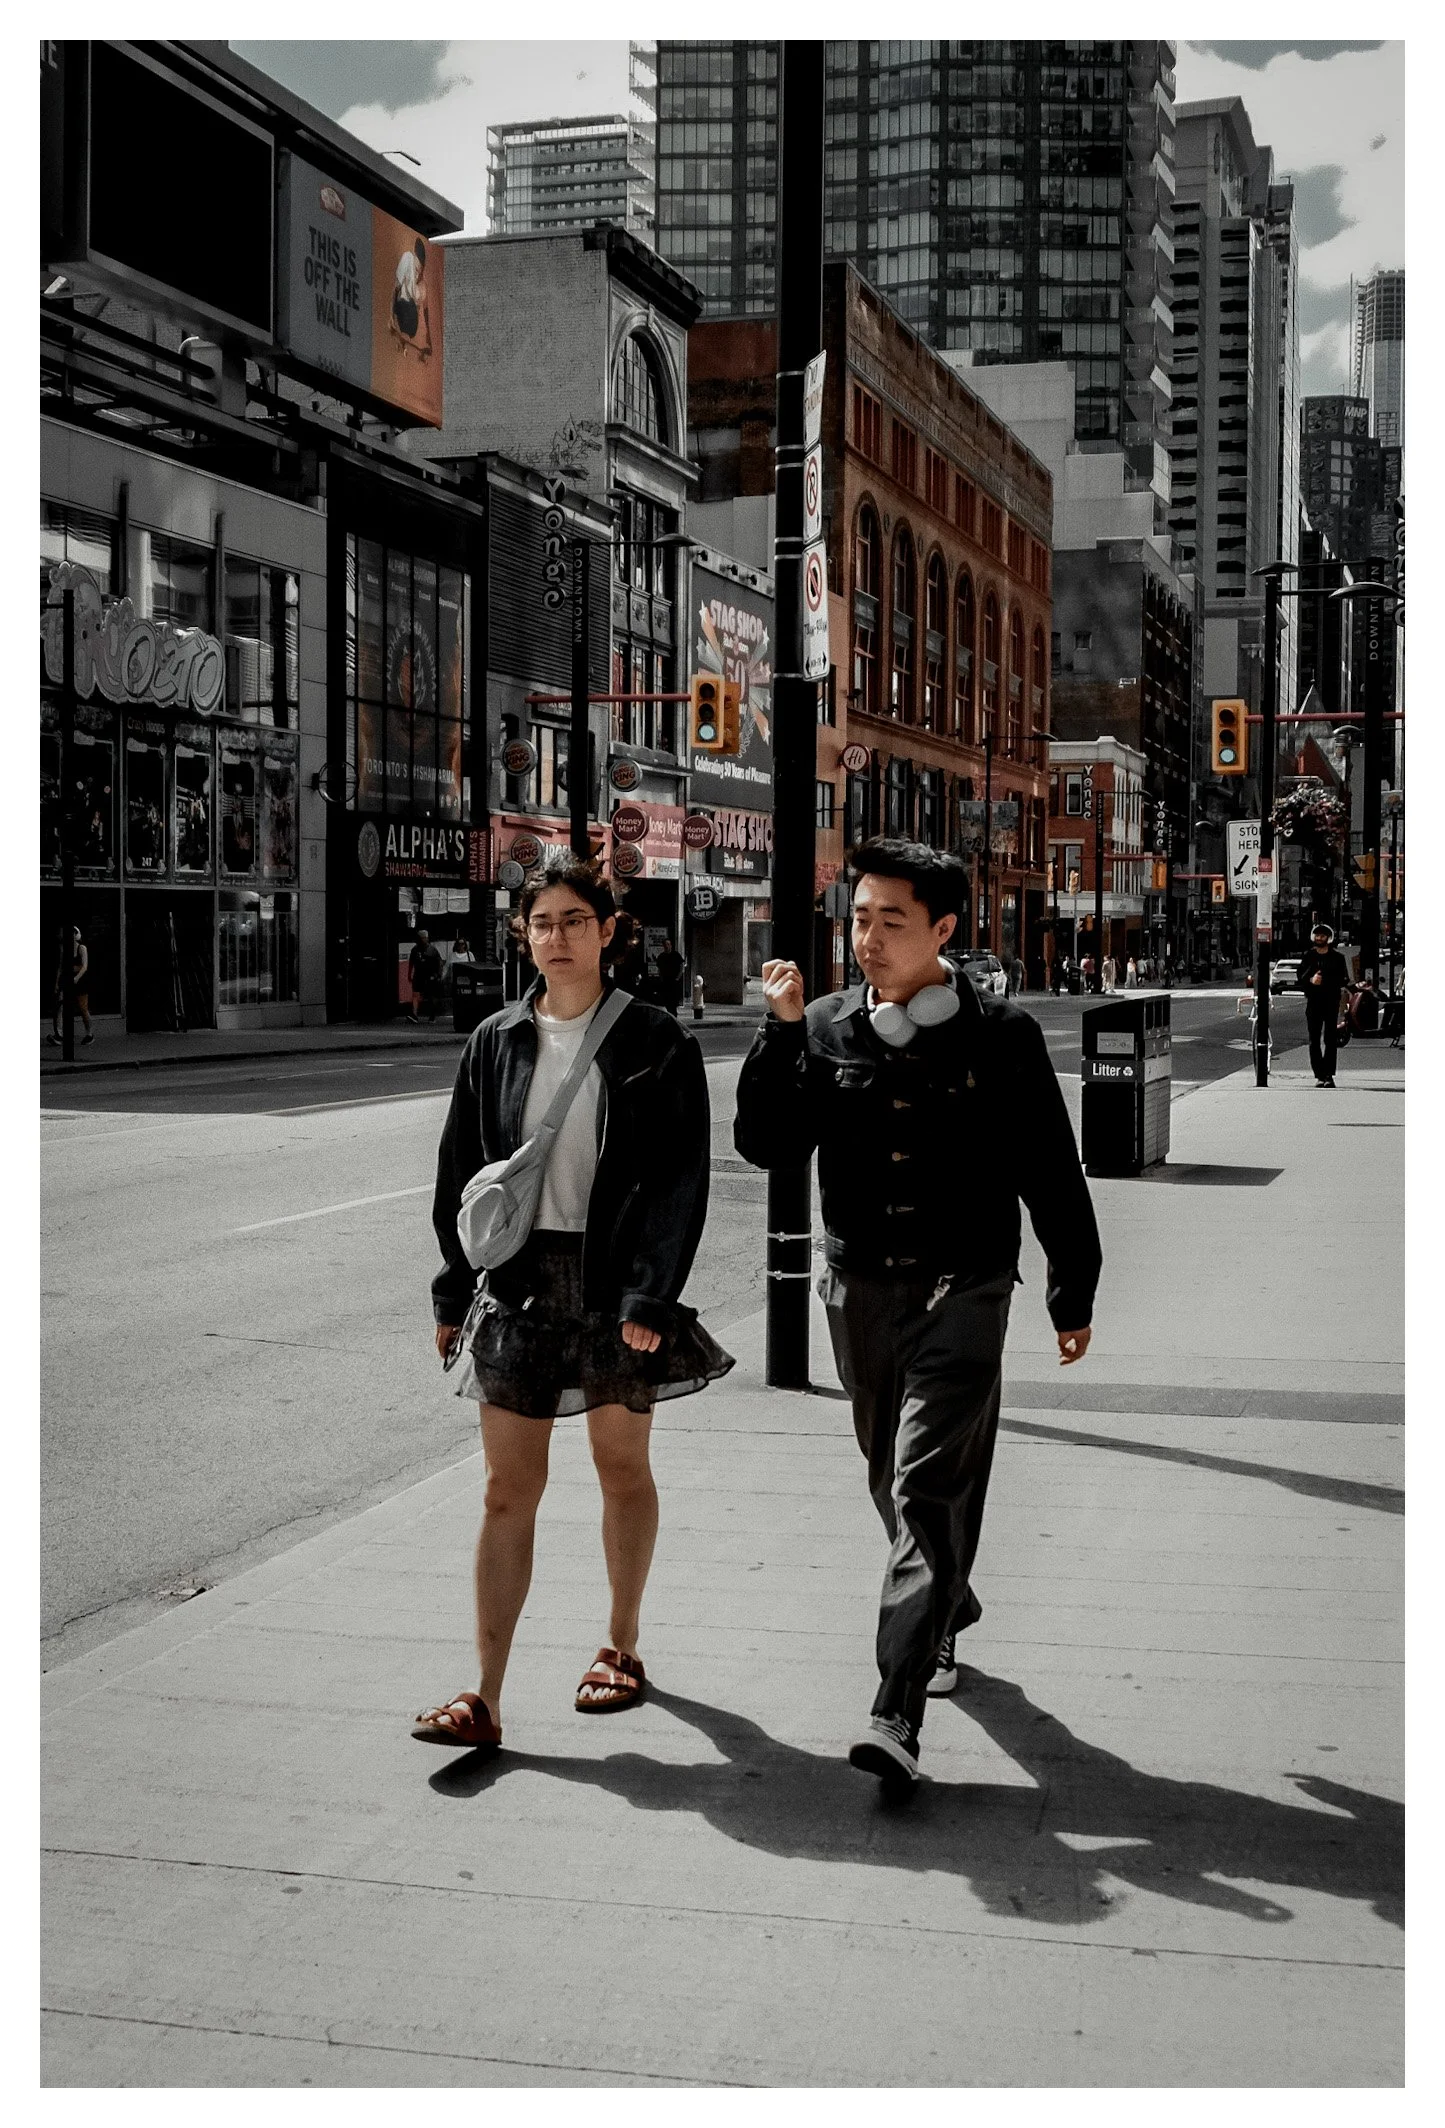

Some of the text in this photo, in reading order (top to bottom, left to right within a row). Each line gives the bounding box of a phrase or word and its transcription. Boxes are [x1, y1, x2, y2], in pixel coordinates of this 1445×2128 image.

[308, 225, 357, 278] THIS IS
[304, 255, 360, 311] OFF THE
[315, 293, 351, 337] WALL
[1344, 406, 1368, 418] MNP
[543, 478, 563, 611] Yonge
[574, 547, 583, 643] DOWNTOWN
[710, 599, 736, 634] STAG
[737, 609, 764, 643] SHOP
[1369, 565, 1379, 661] DOWNTN
[364, 757, 408, 779] TORONTO'S
[613, 771, 636, 782] KING
[694, 754, 771, 785] Celebrating 50 Years of Pleasure
[1083, 764, 1093, 820] Yonge
[615, 817, 642, 827] Money
[618, 825, 638, 833] Mart
[684, 826, 710, 834] Money
[713, 810, 774, 854] STAG SHO
[1156, 800, 1166, 847] Yonge
[1239, 826, 1261, 837] STO
[384, 823, 465, 862] ALPHA'S
[687, 833, 705, 841] Mart
[1238, 841, 1260, 850] HER
[469, 830, 478, 882] ALPHA'S
[478, 830, 487, 882] SHAWARMA
[514, 849, 538, 861] KING
[616, 856, 638, 867] KING
[384, 861, 428, 878] SHAWARMA
[1235, 880, 1258, 891] SIGN
[1092, 1062, 1121, 1077] Litter
